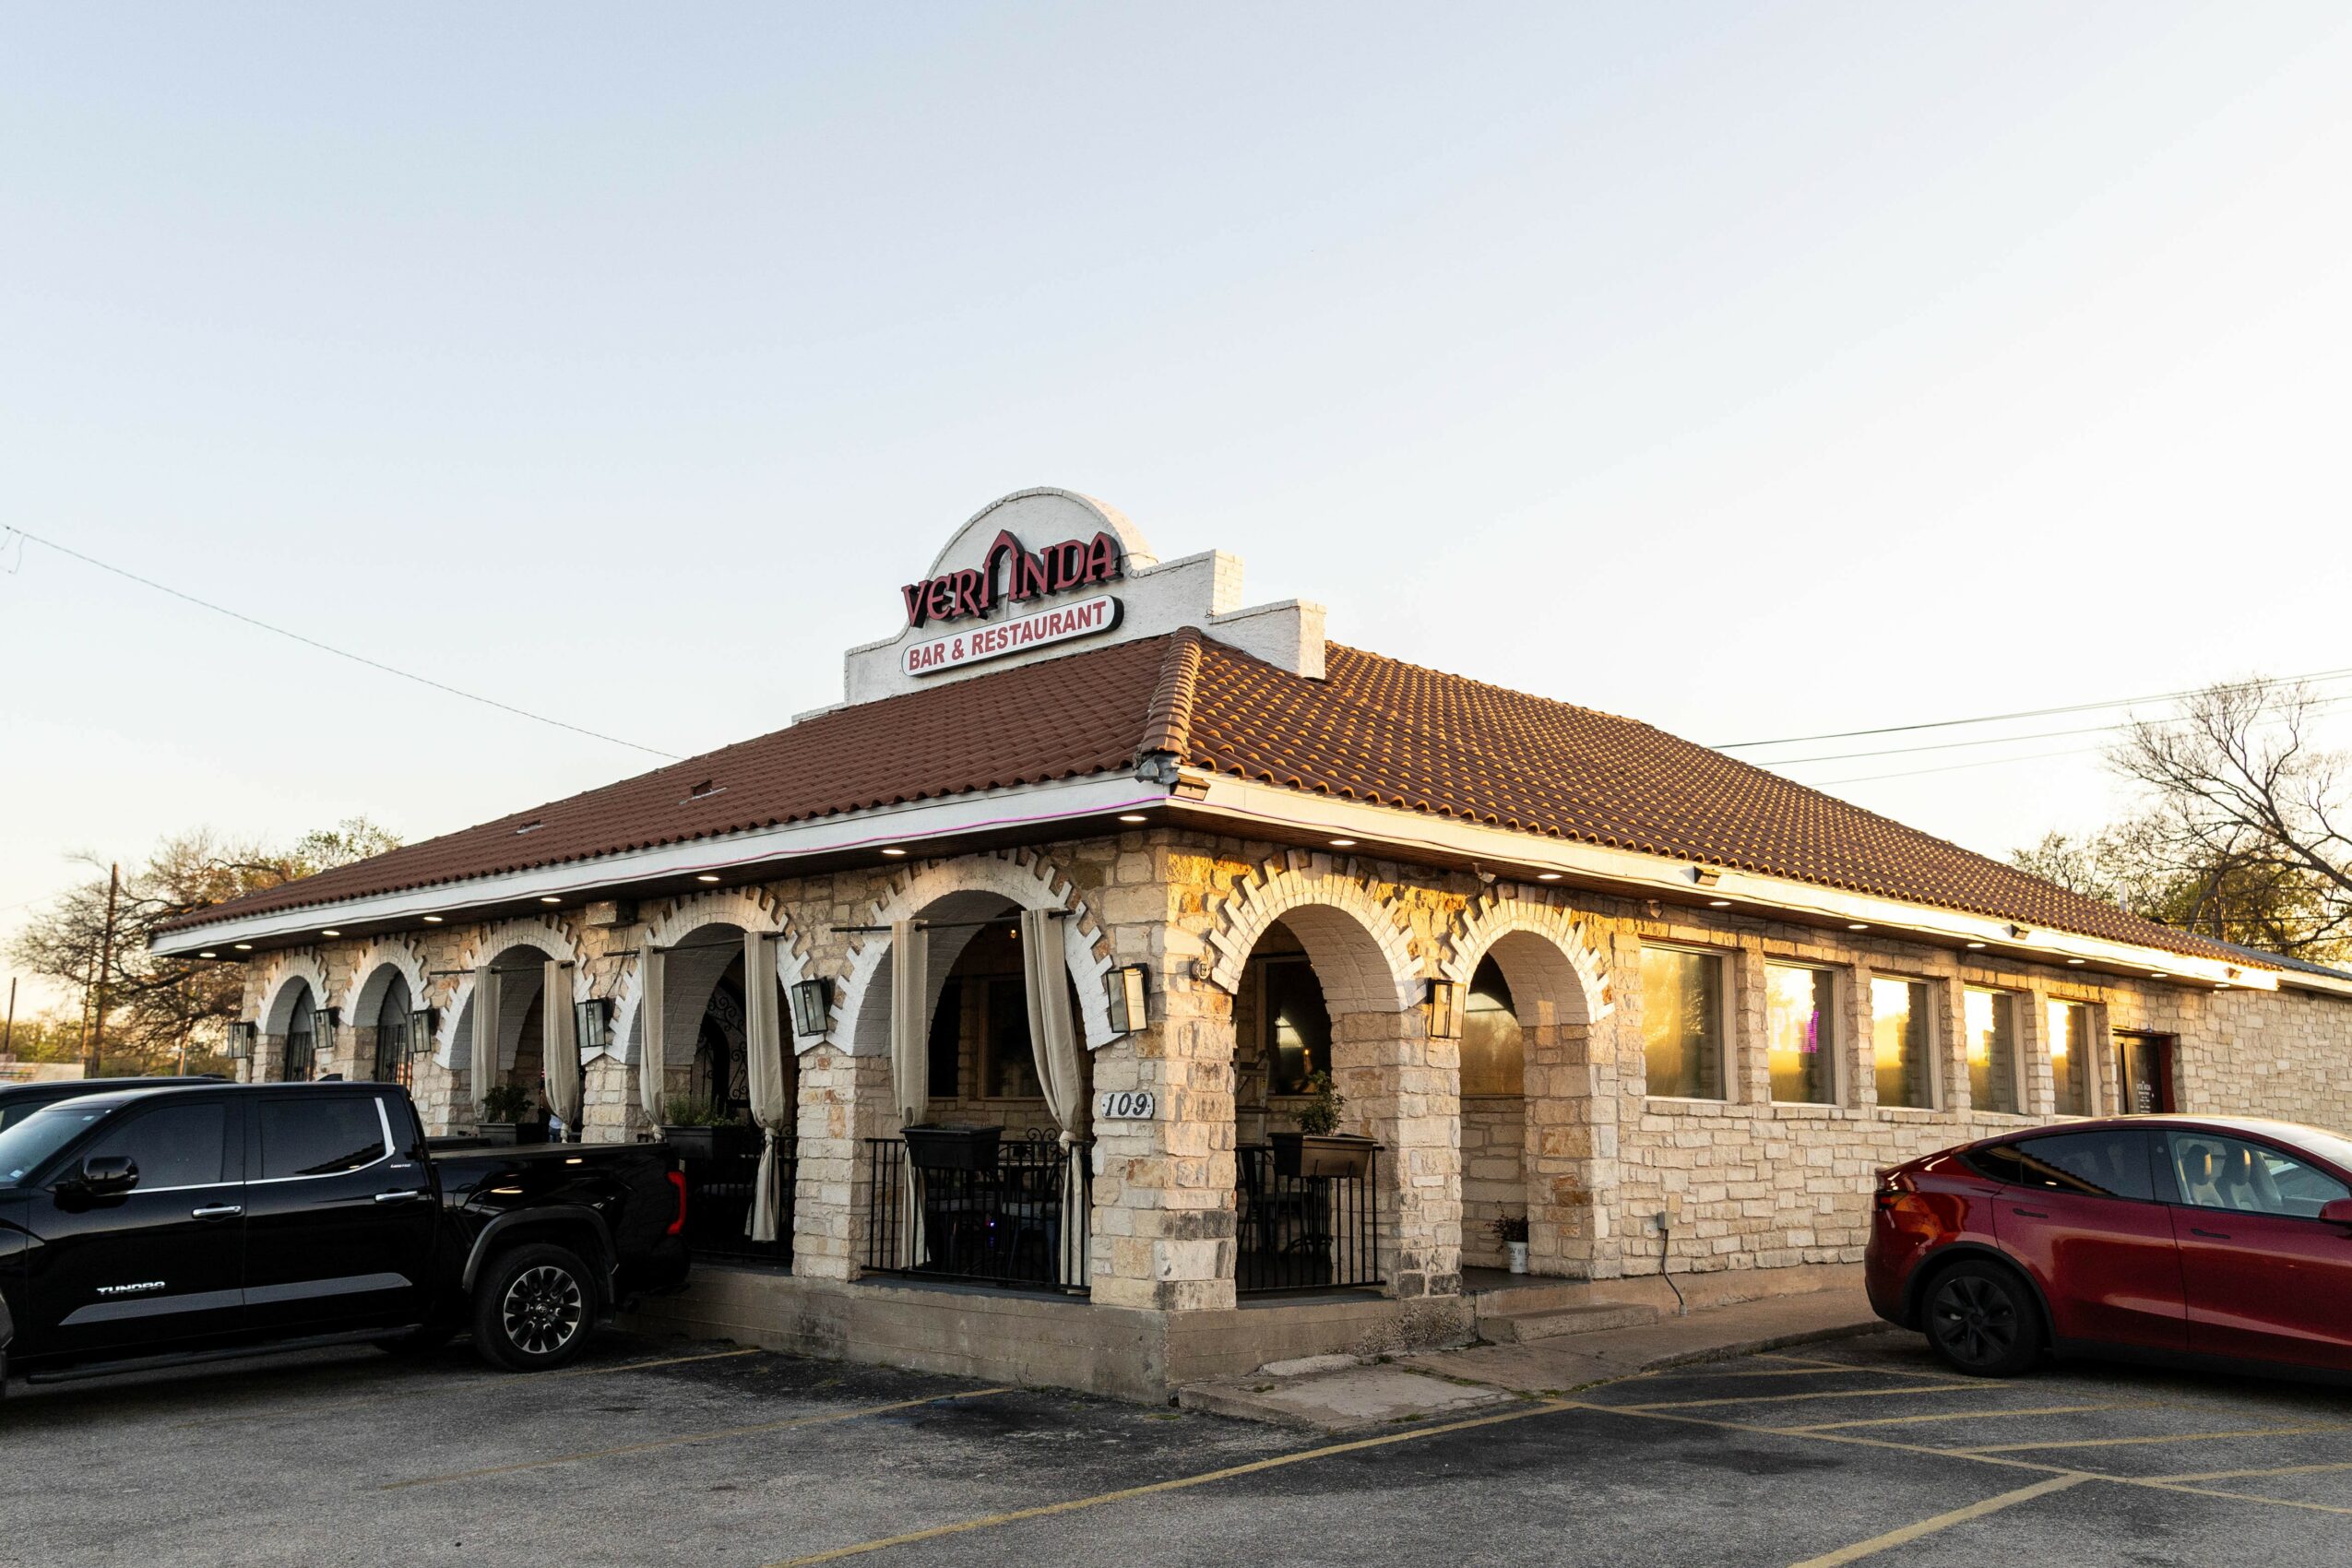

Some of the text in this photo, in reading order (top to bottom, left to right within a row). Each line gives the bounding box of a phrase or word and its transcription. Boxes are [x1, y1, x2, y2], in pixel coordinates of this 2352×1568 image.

[901, 529, 1120, 628] VERANDA
[909, 600, 1107, 671] BAR & RESTAURANT
[1105, 1093, 1147, 1116] 109
